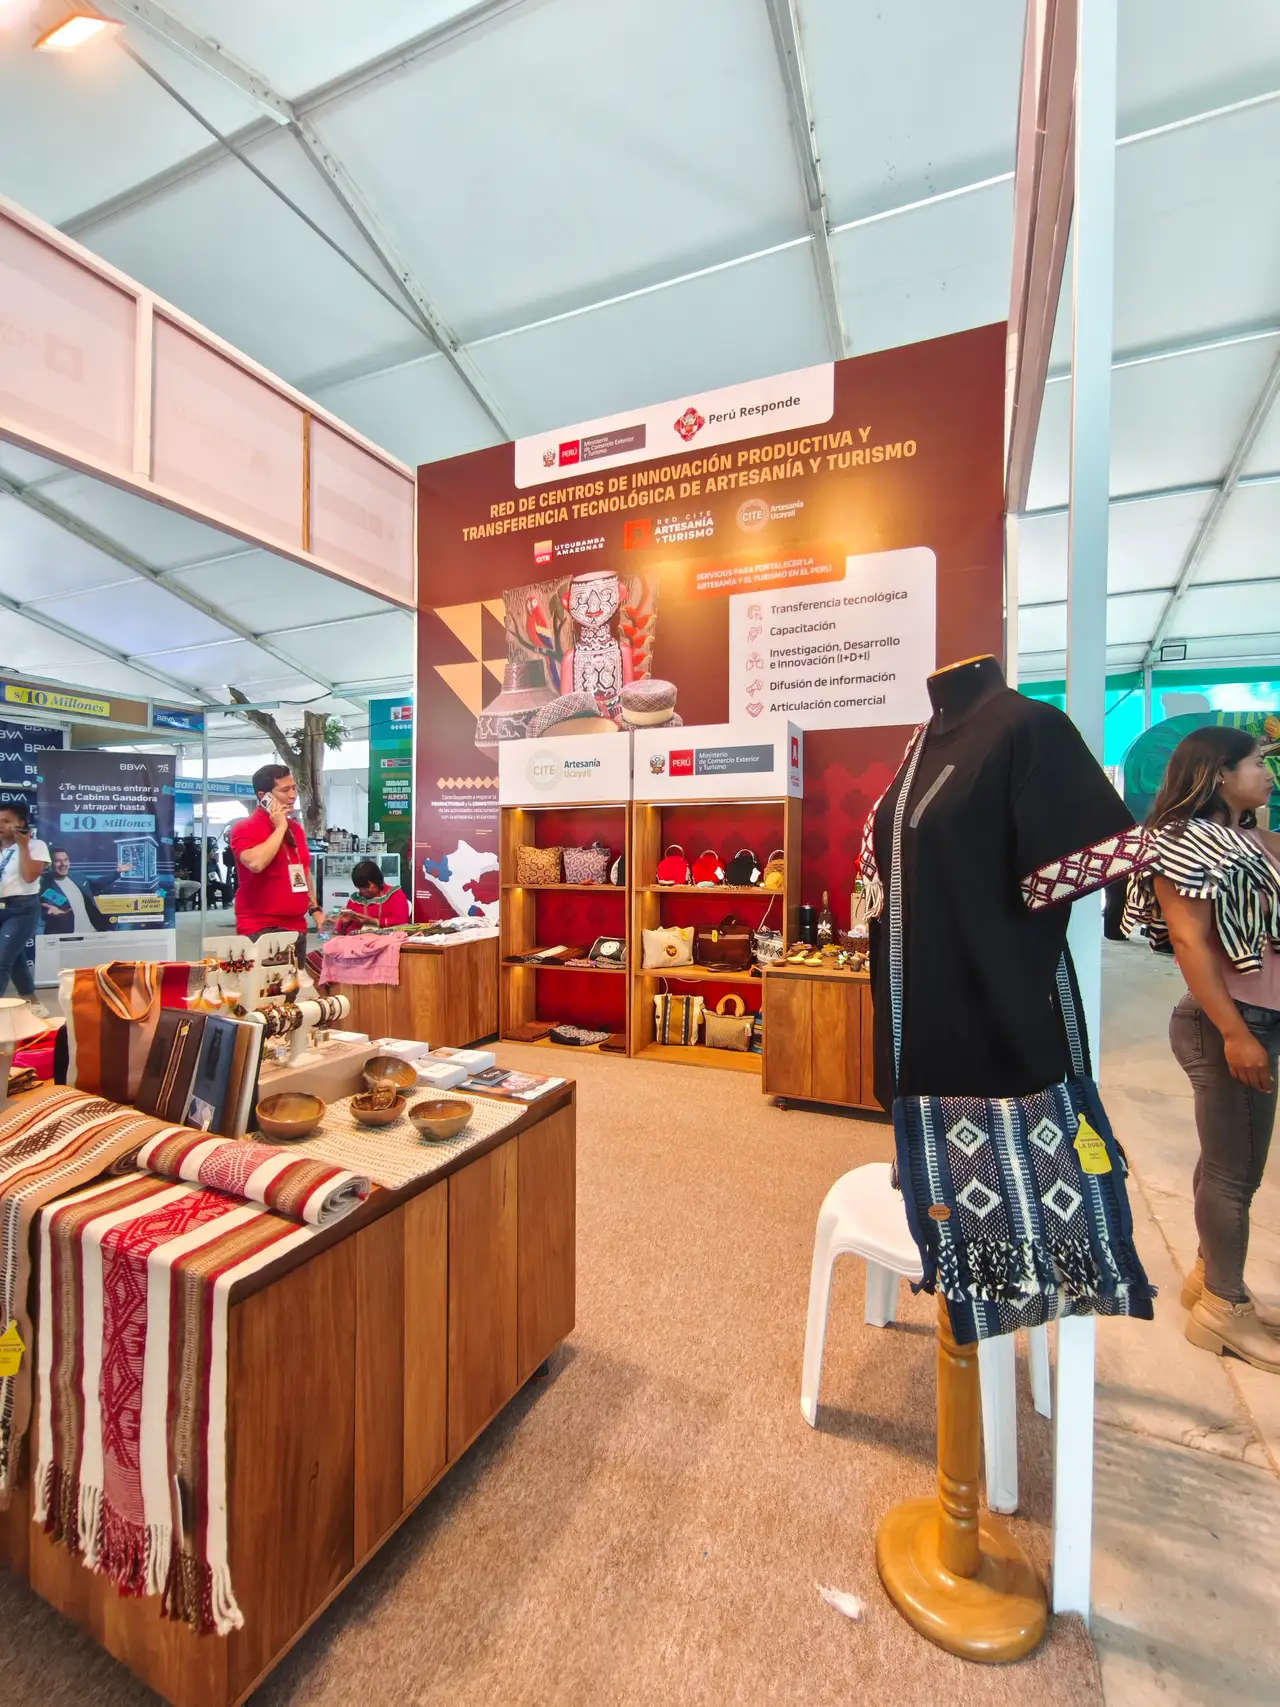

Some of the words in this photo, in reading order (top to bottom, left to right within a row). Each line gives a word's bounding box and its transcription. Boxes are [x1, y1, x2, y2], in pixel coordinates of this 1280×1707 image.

[709, 409, 736, 424] Perú
[739, 396, 801, 418] Responde
[584, 437, 609, 446] Ministerio
[591, 441, 614, 450] Comercio
[615, 436, 634, 445] Exterior
[561, 447, 578, 458] PERÚ
[587, 448, 607, 456] Turismo
[490, 502, 515, 518] RED
[519, 496, 536, 512] DE
[539, 481, 604, 508] CENTROS
[608, 477, 628, 493] DE
[632, 453, 732, 489] INNOVACIÓN
[738, 431, 852, 467] PRODUCTIVA
[858, 426, 872, 443] Y
[463, 507, 568, 541] TRANSFERENCIA
[572, 485, 675, 517] TECNOLÓGICA
[680, 480, 700, 497] DE
[705, 459, 804, 494] ARTESANÍA
[809, 456, 824, 473] Y
[827, 440, 917, 471] TURISMO
[770, 500, 804, 512] Artesanía
[657, 516, 677, 525] RED
[685, 510, 712, 520] CITE
[742, 510, 763, 521] CITE
[770, 510, 796, 520] Ucayali
[654, 518, 714, 535] ARTESANÍA
[662, 528, 714, 544] TURISMO
[554, 536, 606, 551] UTCUBAMBA
[556, 543, 604, 556] AMAZONAS
[536, 555, 550, 563] CITE
[696, 570, 732, 580] SERVICIOS
[734, 566, 754, 575] PARA
[755, 559, 803, 571] FORTALECER
[803, 557, 814, 565] LA
[696, 578, 737, 590] ARTESANÍA
[754, 571, 788, 582] TURISMO
[799, 568, 809, 576] EL
[771, 598, 841, 614] Transferencia
[843, 590, 908, 606] tecnológica
[770, 621, 836, 637] Capacitación
[770, 643, 842, 657] Investigación,
[843, 636, 900, 651] Desarrollo
[770, 661, 776, 669] e
[778, 654, 835, 668] Innovación
[837, 651, 870, 664] (I+D+I)
[770, 679, 812, 691] Difusión
[814, 677, 828, 687] de
[829, 672, 896, 686] información
[50, 695, 105, 714] Millones
[770, 699, 832, 712] Articulación
[833, 695, 886, 708] comercial
[156, 714, 176, 723] BBVA
[0, 730, 23, 739] BVA
[0, 752, 22, 762] BVA
[672, 757, 691, 767] PERÚ
[707, 757, 735, 765] Comercio
[736, 755, 760, 763] Exterior
[119, 763, 147, 771] BBVA
[564, 758, 601, 768] Artesanía
[533, 765, 555, 776] CITE
[564, 769, 591, 779] Ucayali
[59, 783, 76, 793] ¿Te
[78, 783, 122, 794] imaginas
[123, 785, 152, 793] entrar
[1, 792, 28, 802] BVA
[61, 793, 74, 801] La
[75, 793, 110, 801] Cabina
[112, 793, 158, 802] Ganadora
[82, 803, 117, 812] atrapar
[119, 803, 146, 811] hasta
[102, 818, 153, 828] Millones
